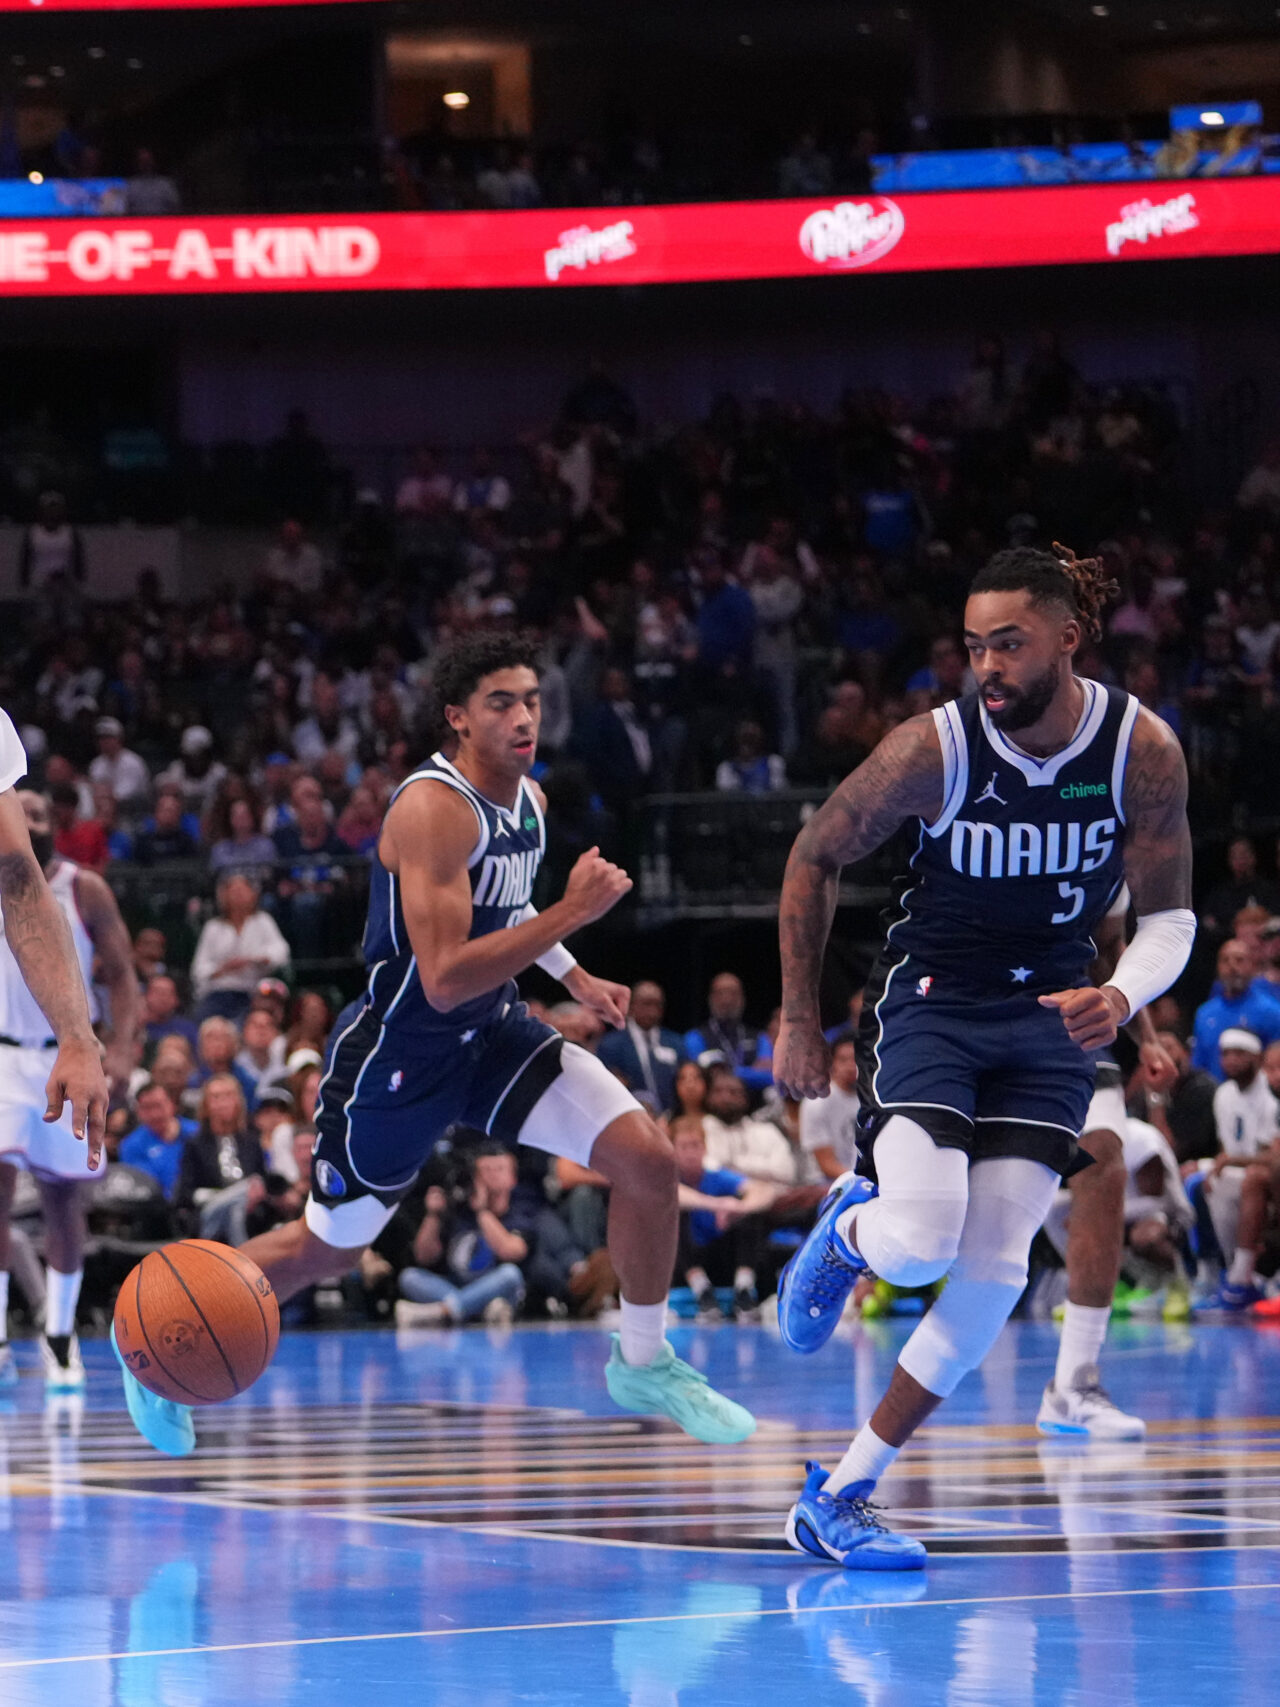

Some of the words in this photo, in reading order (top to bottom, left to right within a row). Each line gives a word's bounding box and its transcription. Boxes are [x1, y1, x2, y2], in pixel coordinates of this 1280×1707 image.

[1059, 782, 1108, 800] chime
[949, 817, 1116, 879] MAVS
[1050, 880, 1086, 925] 5
